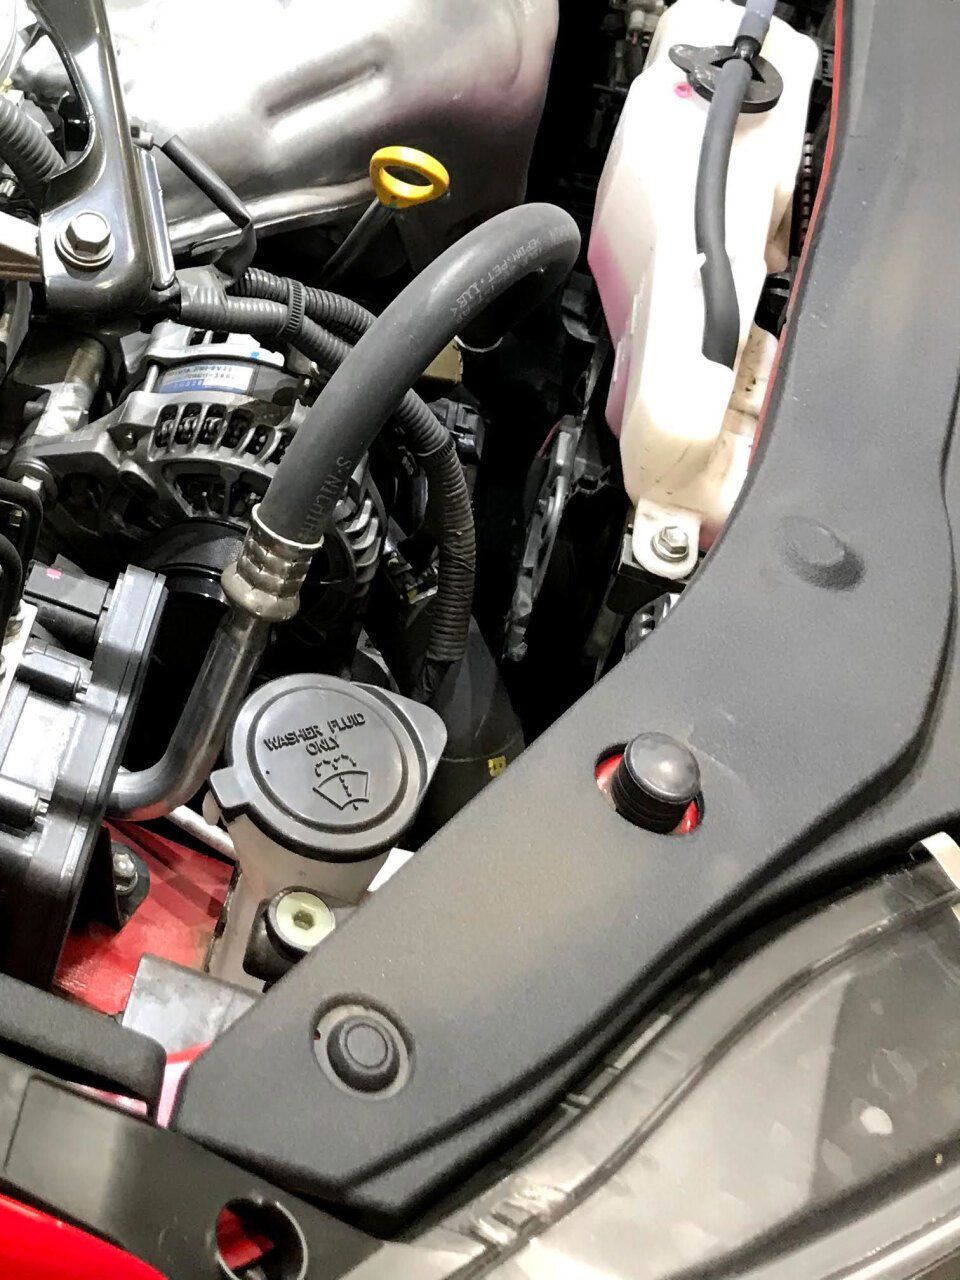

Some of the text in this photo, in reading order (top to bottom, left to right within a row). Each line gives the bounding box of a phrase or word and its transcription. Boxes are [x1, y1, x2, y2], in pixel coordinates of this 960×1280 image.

[262, 712, 366, 751] WASHER FLUID
[305, 737, 341, 756] ONLY
